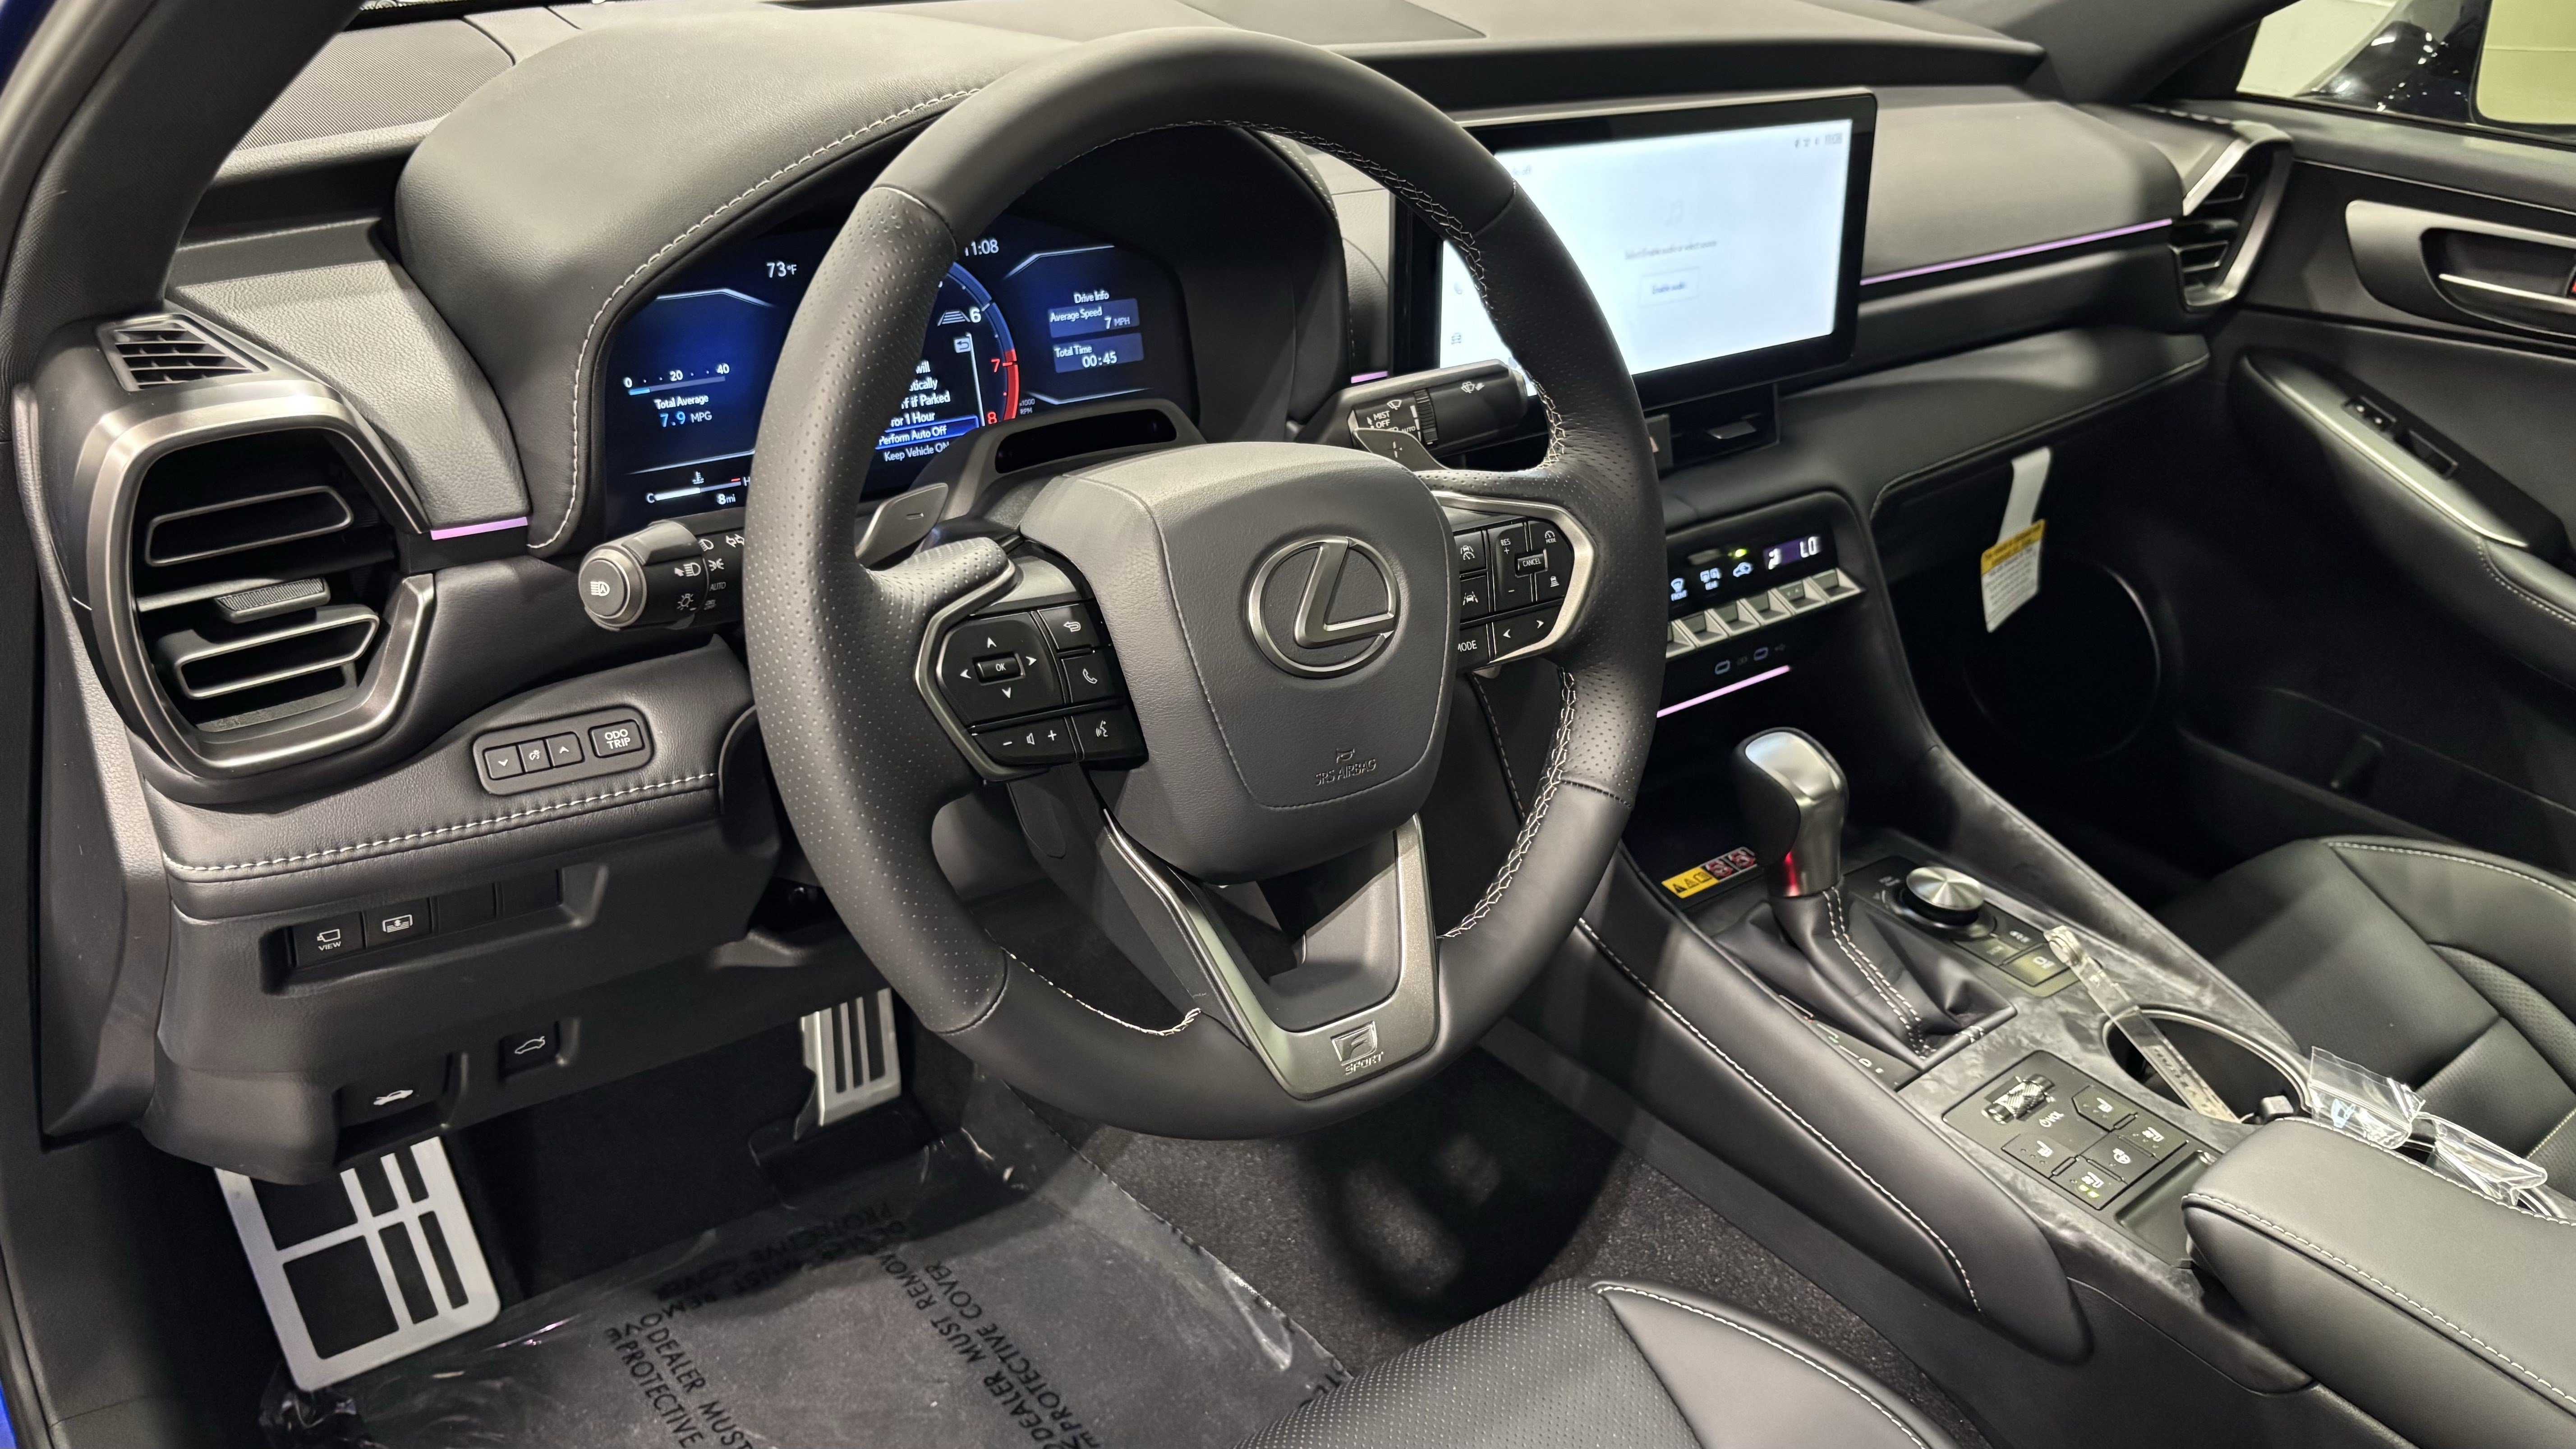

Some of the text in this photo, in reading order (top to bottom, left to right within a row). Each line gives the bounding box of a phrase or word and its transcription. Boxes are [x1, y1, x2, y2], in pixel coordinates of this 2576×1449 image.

[1074, 290, 1109, 304] Drive Info
[969, 308, 981, 323] 6
[1050, 306, 1103, 322] Average Speed
[1104, 316, 1130, 329] 7 MPH
[1054, 345, 1092, 358] Total Time
[991, 359, 1000, 373] 7
[1082, 350, 1117, 368] 00:45
[623, 363, 730, 388] 0 20 40
[654, 395, 709, 409] Total Average
[910, 395, 918, 408] if
[919, 390, 951, 406] Parked
[660, 411, 712, 427] 7.9 MPG
[904, 413, 910, 425] 1
[911, 411, 935, 424] Hour
[987, 411, 997, 424] 8
[1373, 410, 1390, 420] MIST
[1375, 419, 1390, 428] OFF
[879, 424, 947, 446] Perform Auto Off
[884, 451, 905, 462] Keep
[905, 445, 934, 458] Vehicle
[646, 493, 655, 503] C
[1500, 538, 1511, 546] RES
[1523, 558, 1541, 567] CANCEL
[709, 581, 726, 591] AUTO
[995, 662, 1007, 672] OK
[605, 728, 628, 741] ODO
[606, 737, 630, 749] TRIP
[1337, 759, 1376, 780] AIRBAG
[318, 941, 341, 951] VIEW
[925, 1261, 983, 1320] COVER
[877, 1253, 1054, 1442] DEALER MUST REMOV
[647, 1327, 706, 1394] DEALER
[975, 1323, 1082, 1431] PROTECTIVE
[616, 1340, 704, 1449] PROTECTIVE
